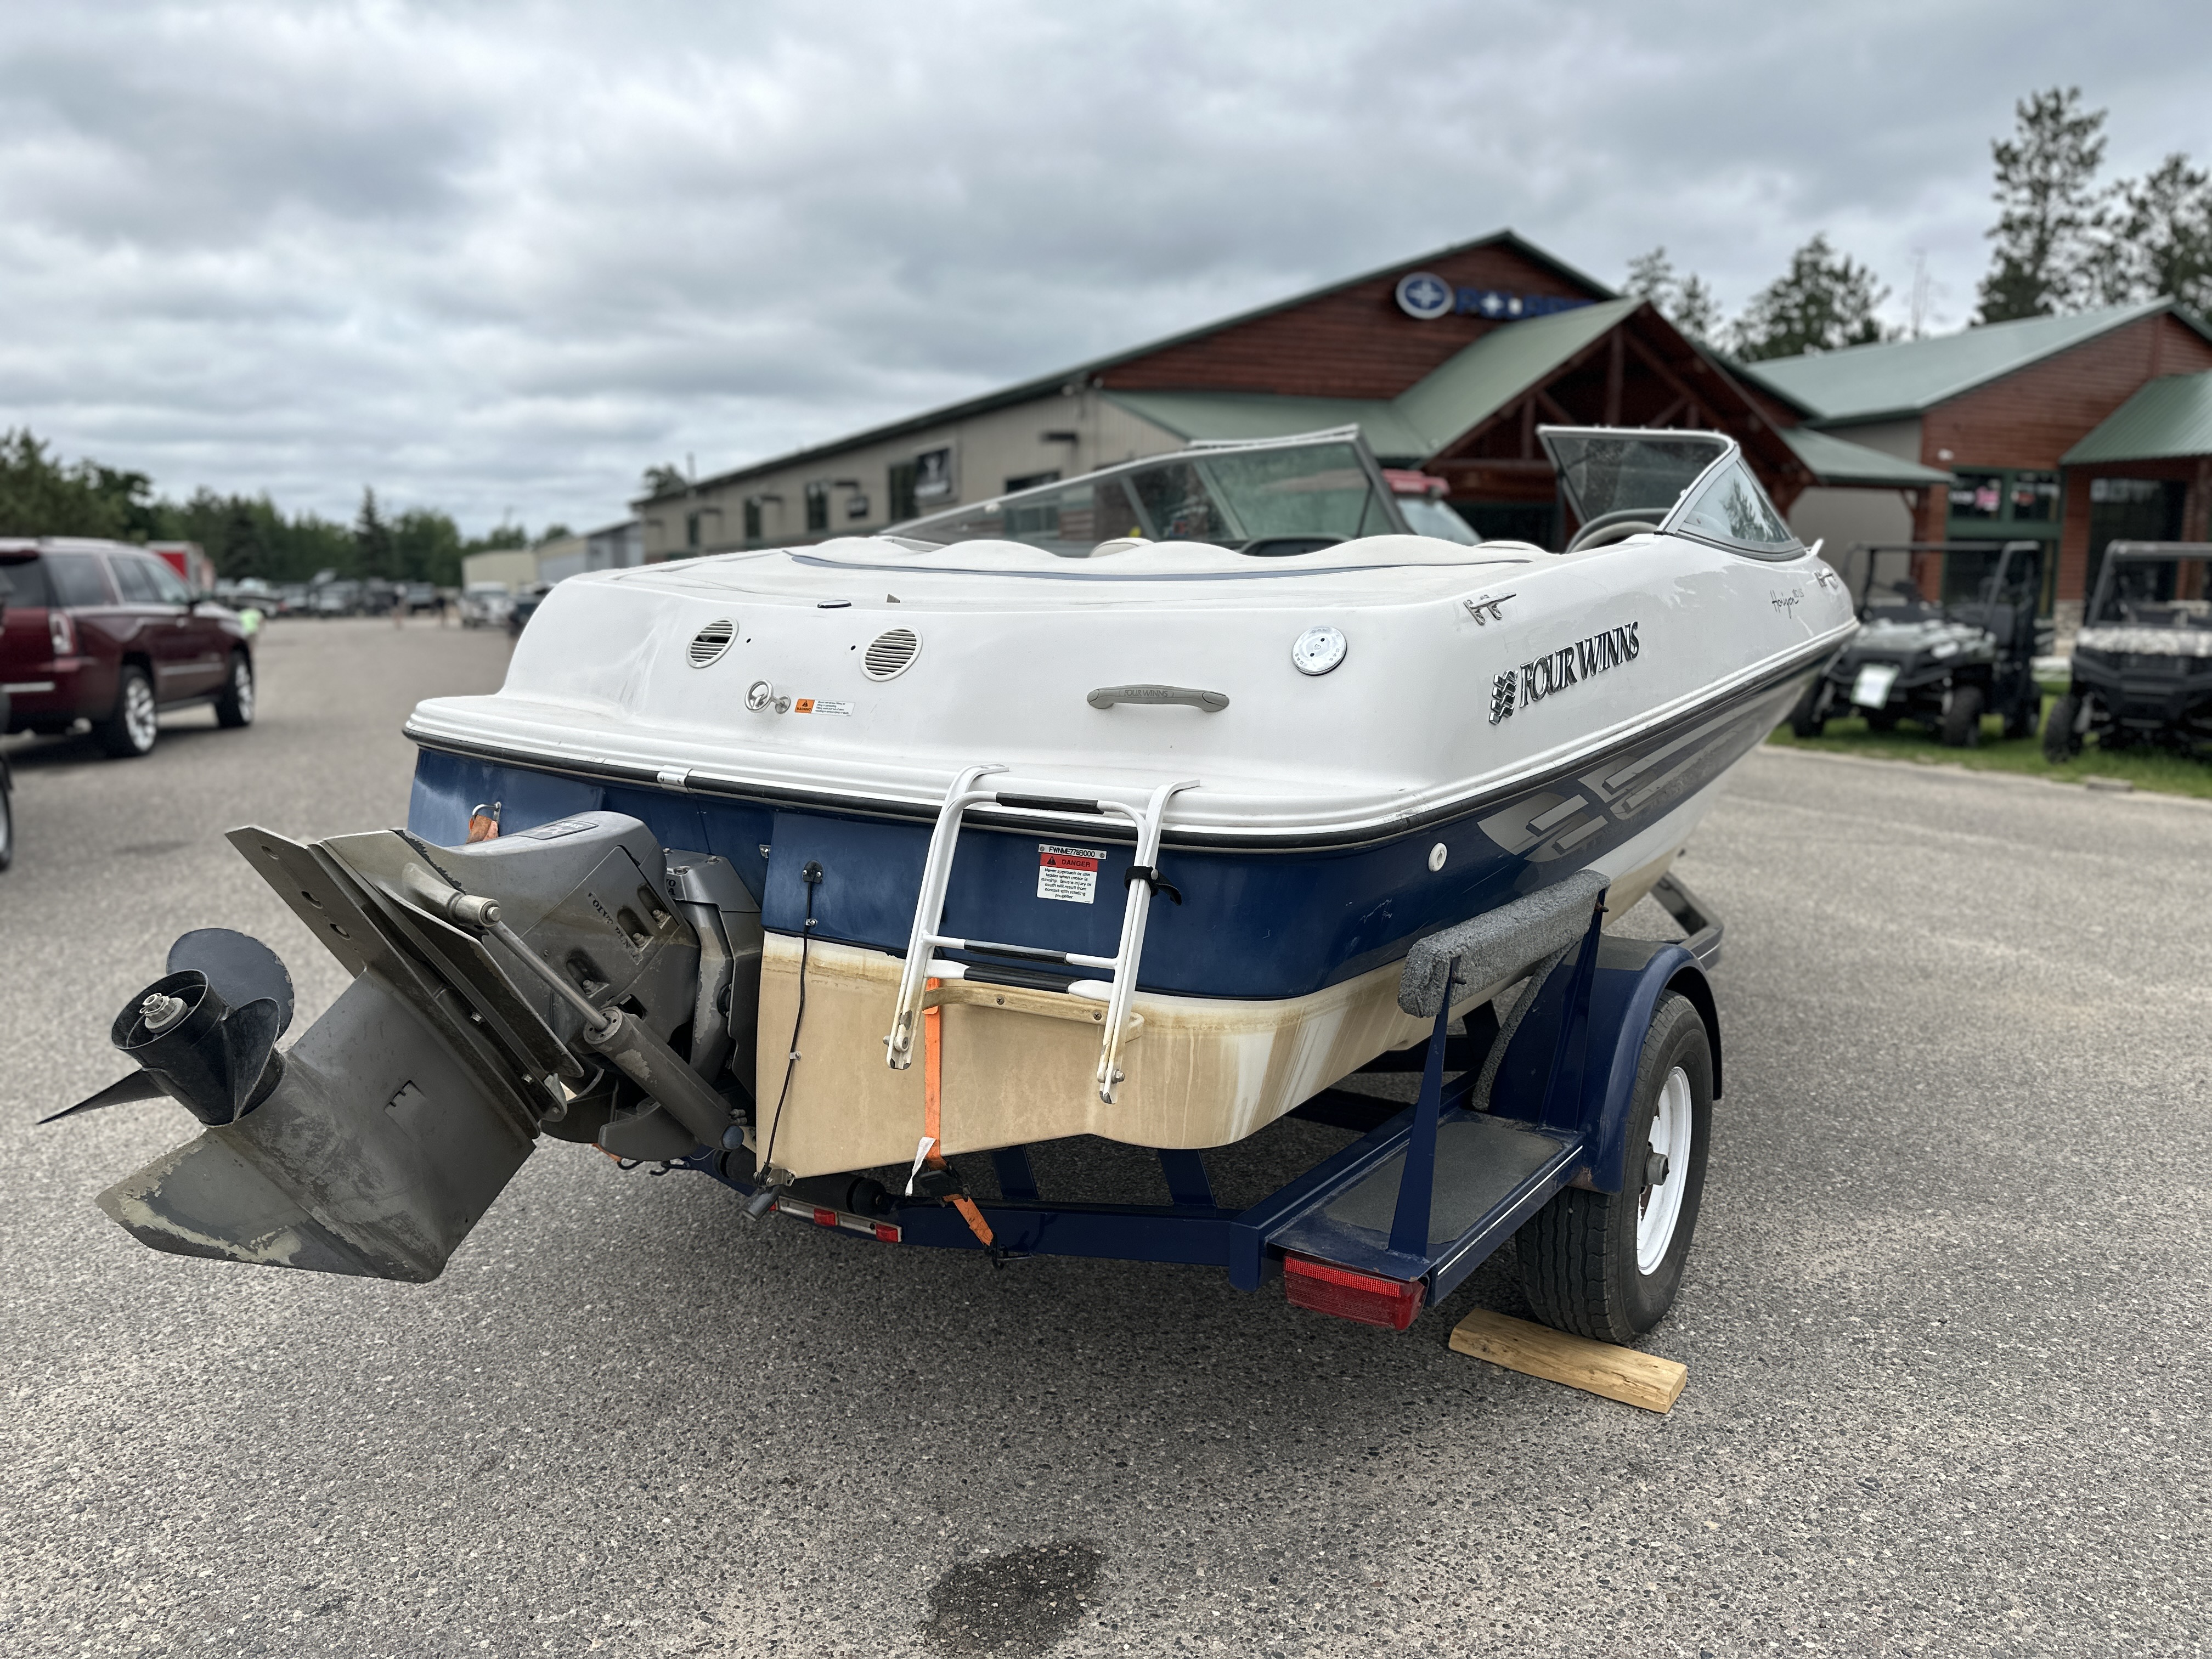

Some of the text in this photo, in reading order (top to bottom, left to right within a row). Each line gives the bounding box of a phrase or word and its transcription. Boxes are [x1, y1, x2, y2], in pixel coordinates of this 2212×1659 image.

[1519, 621, 1639, 708] FOUR WINNS
[1062, 859, 1091, 867] DANGER
